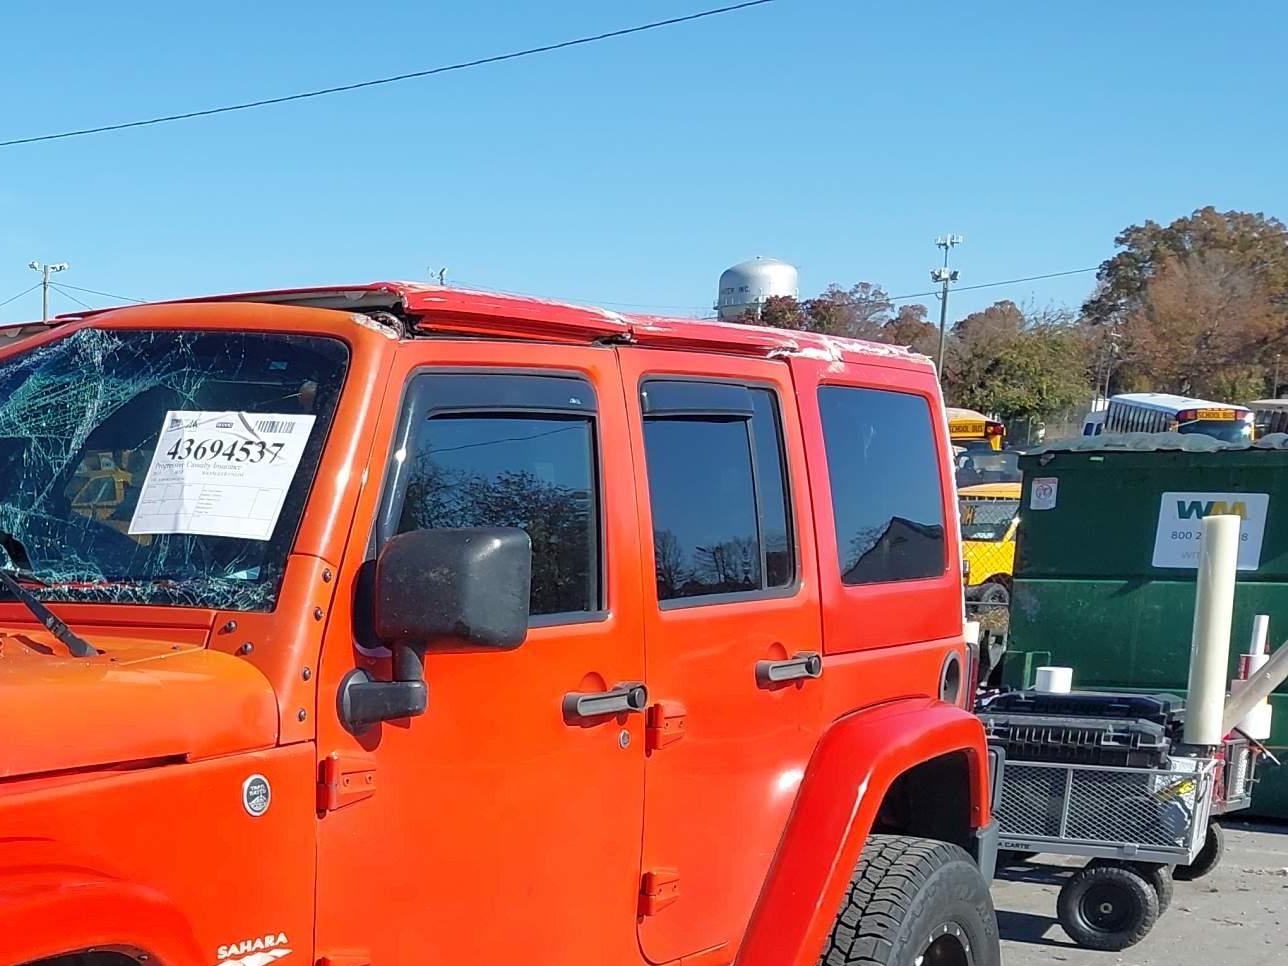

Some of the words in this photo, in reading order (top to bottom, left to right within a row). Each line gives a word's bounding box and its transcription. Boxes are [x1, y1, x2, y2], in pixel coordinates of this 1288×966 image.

[167, 438, 285, 464] 43694537
[1171, 531, 1193, 540] 800
[217, 932, 288, 959] SAHARA
